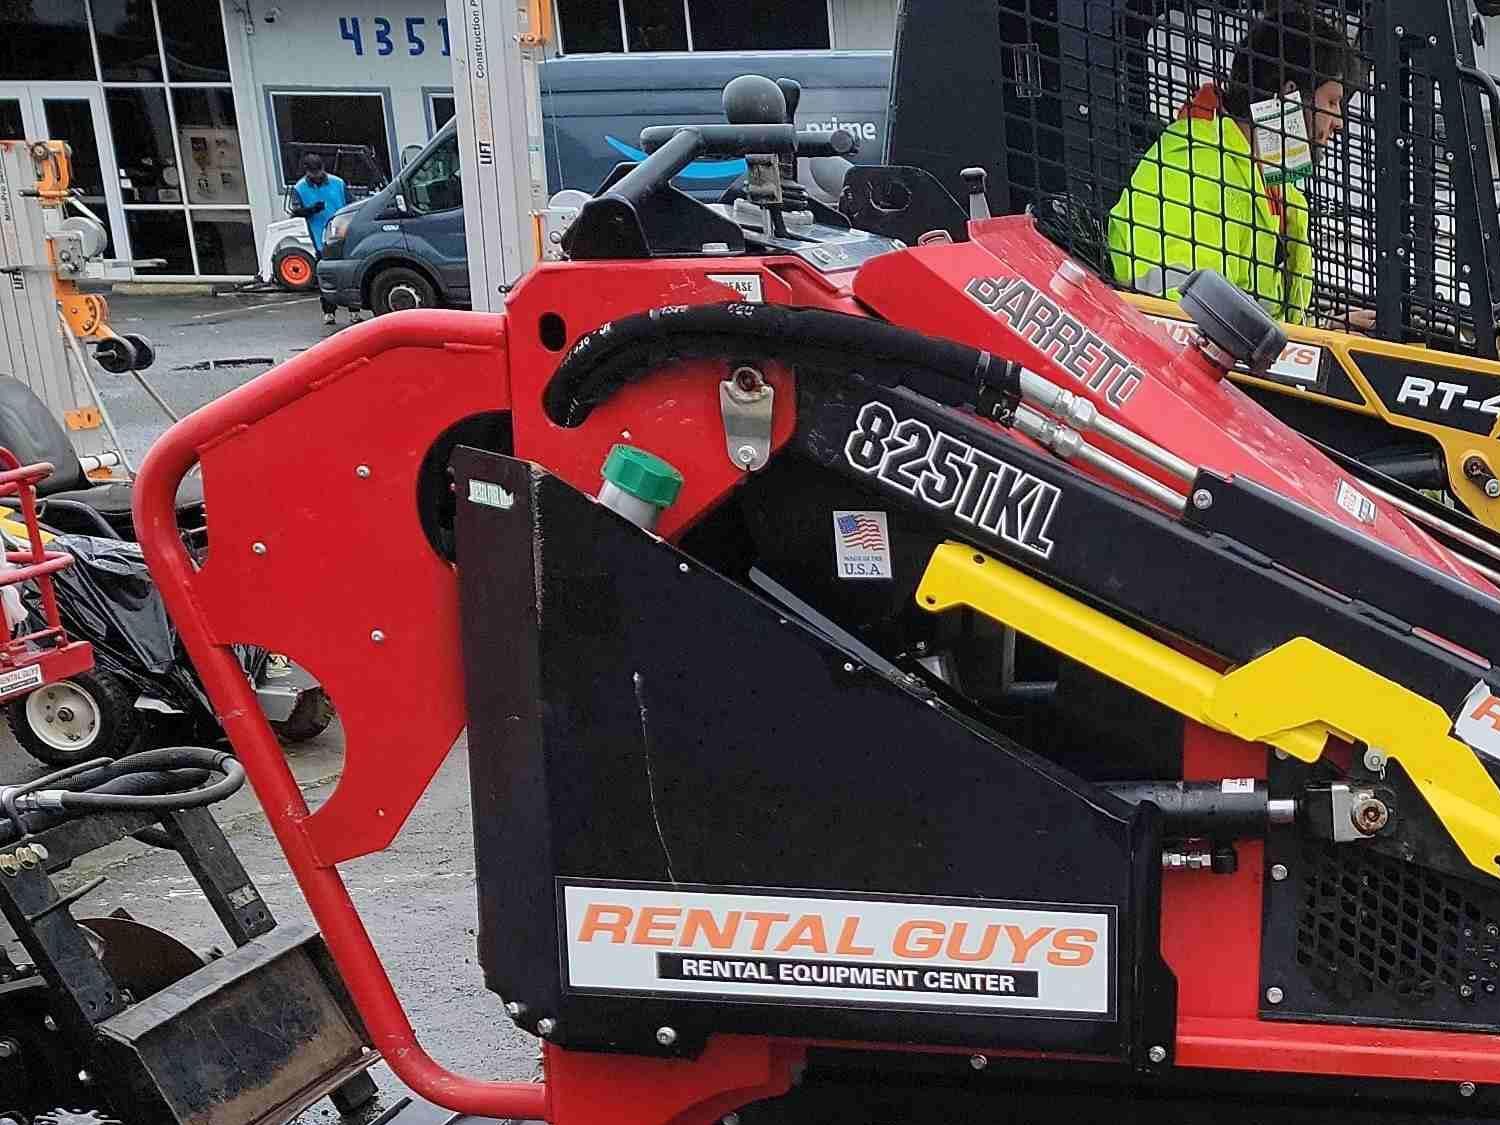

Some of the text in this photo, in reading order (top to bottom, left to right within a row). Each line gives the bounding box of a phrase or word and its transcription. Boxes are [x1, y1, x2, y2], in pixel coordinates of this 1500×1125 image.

[339, 17, 450, 56] 4351
[478, 140, 493, 165] LIFT
[964, 277, 1146, 410] BARRETO
[844, 400, 1063, 560] 825TKL
[844, 562, 885, 576] U.S.A.
[577, 903, 1099, 968] RENTAL GUYS
[682, 958, 1016, 993] RENTAL EQUIPMENT CENTER
